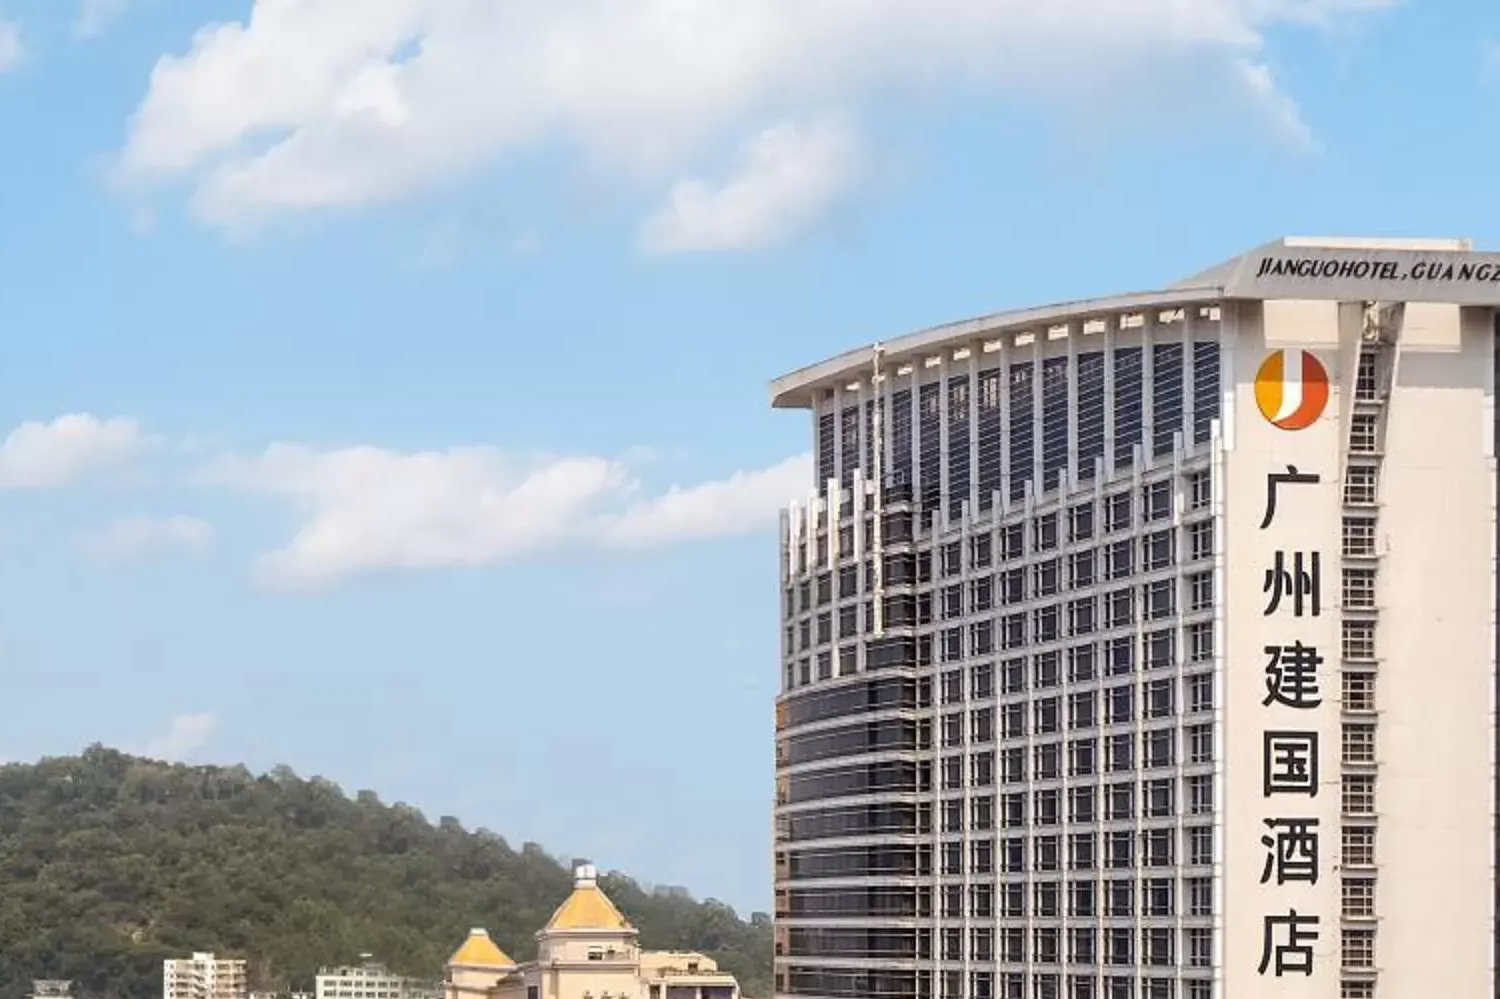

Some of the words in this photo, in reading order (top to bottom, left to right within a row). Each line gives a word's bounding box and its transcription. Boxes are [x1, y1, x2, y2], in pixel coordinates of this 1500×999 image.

[1257, 465, 1324, 977] 广州建国酒店
